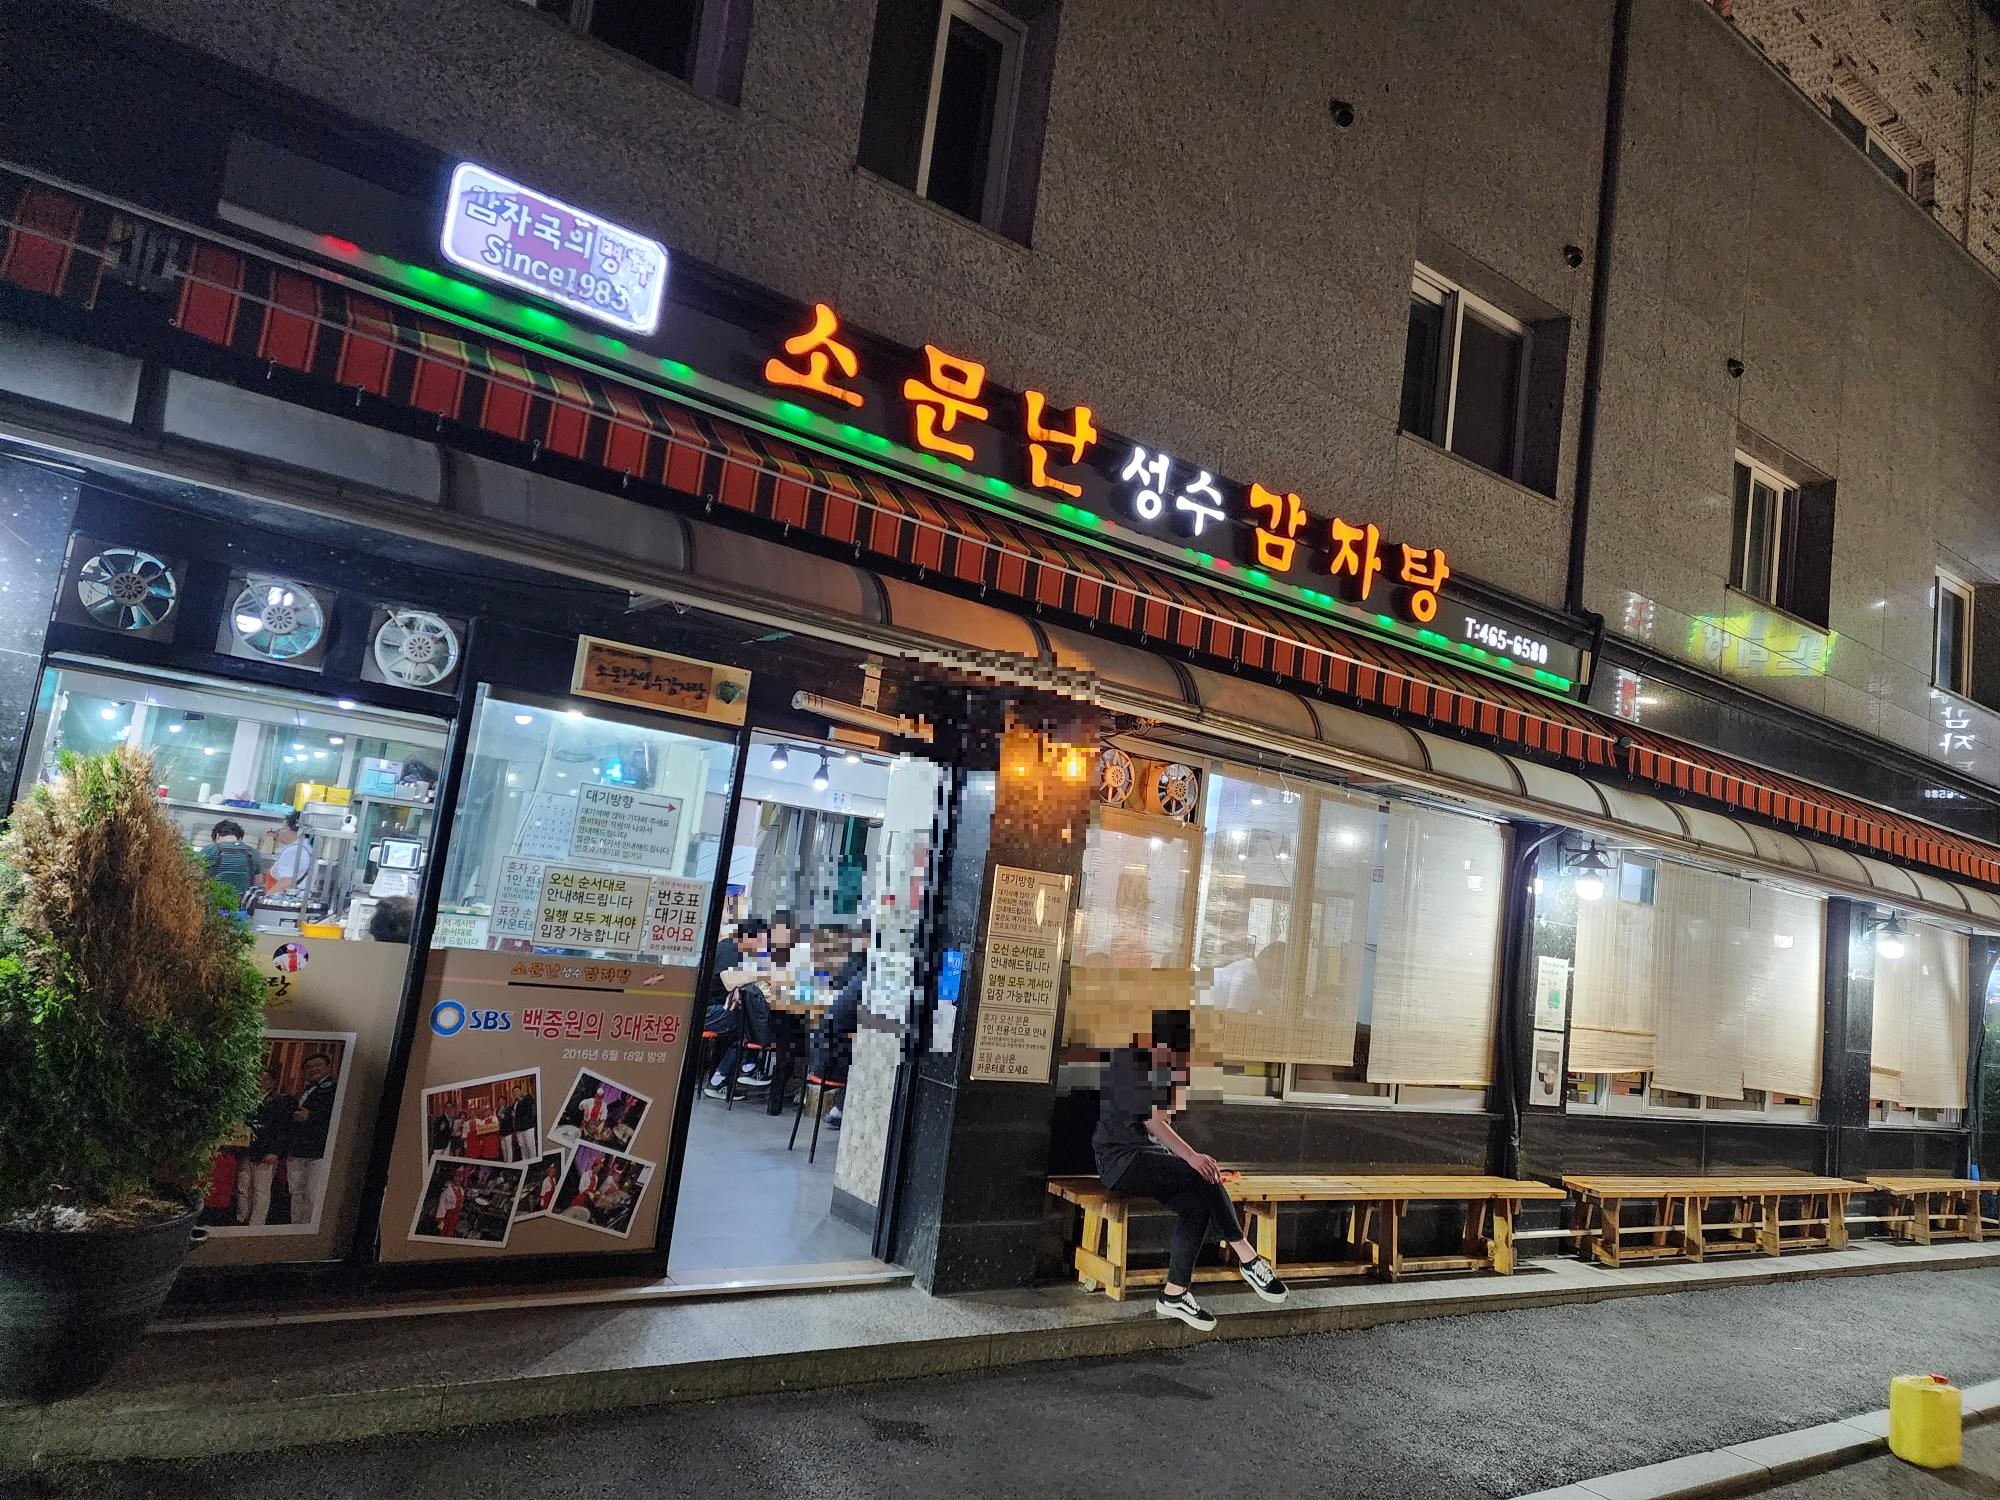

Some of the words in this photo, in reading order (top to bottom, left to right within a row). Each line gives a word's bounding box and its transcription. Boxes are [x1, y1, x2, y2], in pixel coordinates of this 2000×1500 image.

[466, 185, 593, 259] 감자국의
[765, 303, 1098, 498] 소문난
[1122, 446, 1226, 537] 성수
[1250, 482, 1449, 623] 감자탕
[1464, 616, 1548, 665] T:465-6580
[586, 790, 634, 809] 대기방향
[506, 874, 522, 886] 1인
[549, 873, 574, 887] 오신
[578, 876, 626, 892] 순서대로
[1001, 873, 1035, 889] 대기방향
[547, 888, 632, 909] 안내해드립니다
[658, 890, 699, 907] 번호표
[544, 908, 568, 924] 일행
[571, 912, 596, 926] 모두
[600, 914, 636, 929] 계셔야
[654, 908, 696, 925] 대기표
[541, 924, 566, 940] 입장
[569, 927, 630, 944] 가능합니다
[652, 925, 694, 942] 없어요
[991, 943, 1009, 955] 오신
[1012, 945, 1045, 959] 순서대로
[562, 967, 582, 979] 성수
[991, 956, 1050, 974] 안내해드립니다
[989, 974, 1006, 987] 일행
[1007, 976, 1025, 988] 모두
[987, 988, 1004, 1001] 입장
[1007, 990, 1049, 1004] 가능합니다
[469, 1009, 513, 1031] SBS
[522, 1008, 604, 1041] 백종원의
[610, 1014, 680, 1043] 3대천왕
[983, 1024, 993, 1035] 1인
[996, 1025, 1030, 1036] 전용석으로
[1033, 1029, 1046, 1038] 안내
[562, 1048, 598, 1061] 2016년
[601, 1049, 619, 1062] 6월
[623, 1050, 644, 1063] 18일
[977, 1063, 1006, 1074] 카운터로
[1008, 1065, 1028, 1075] 오세요
